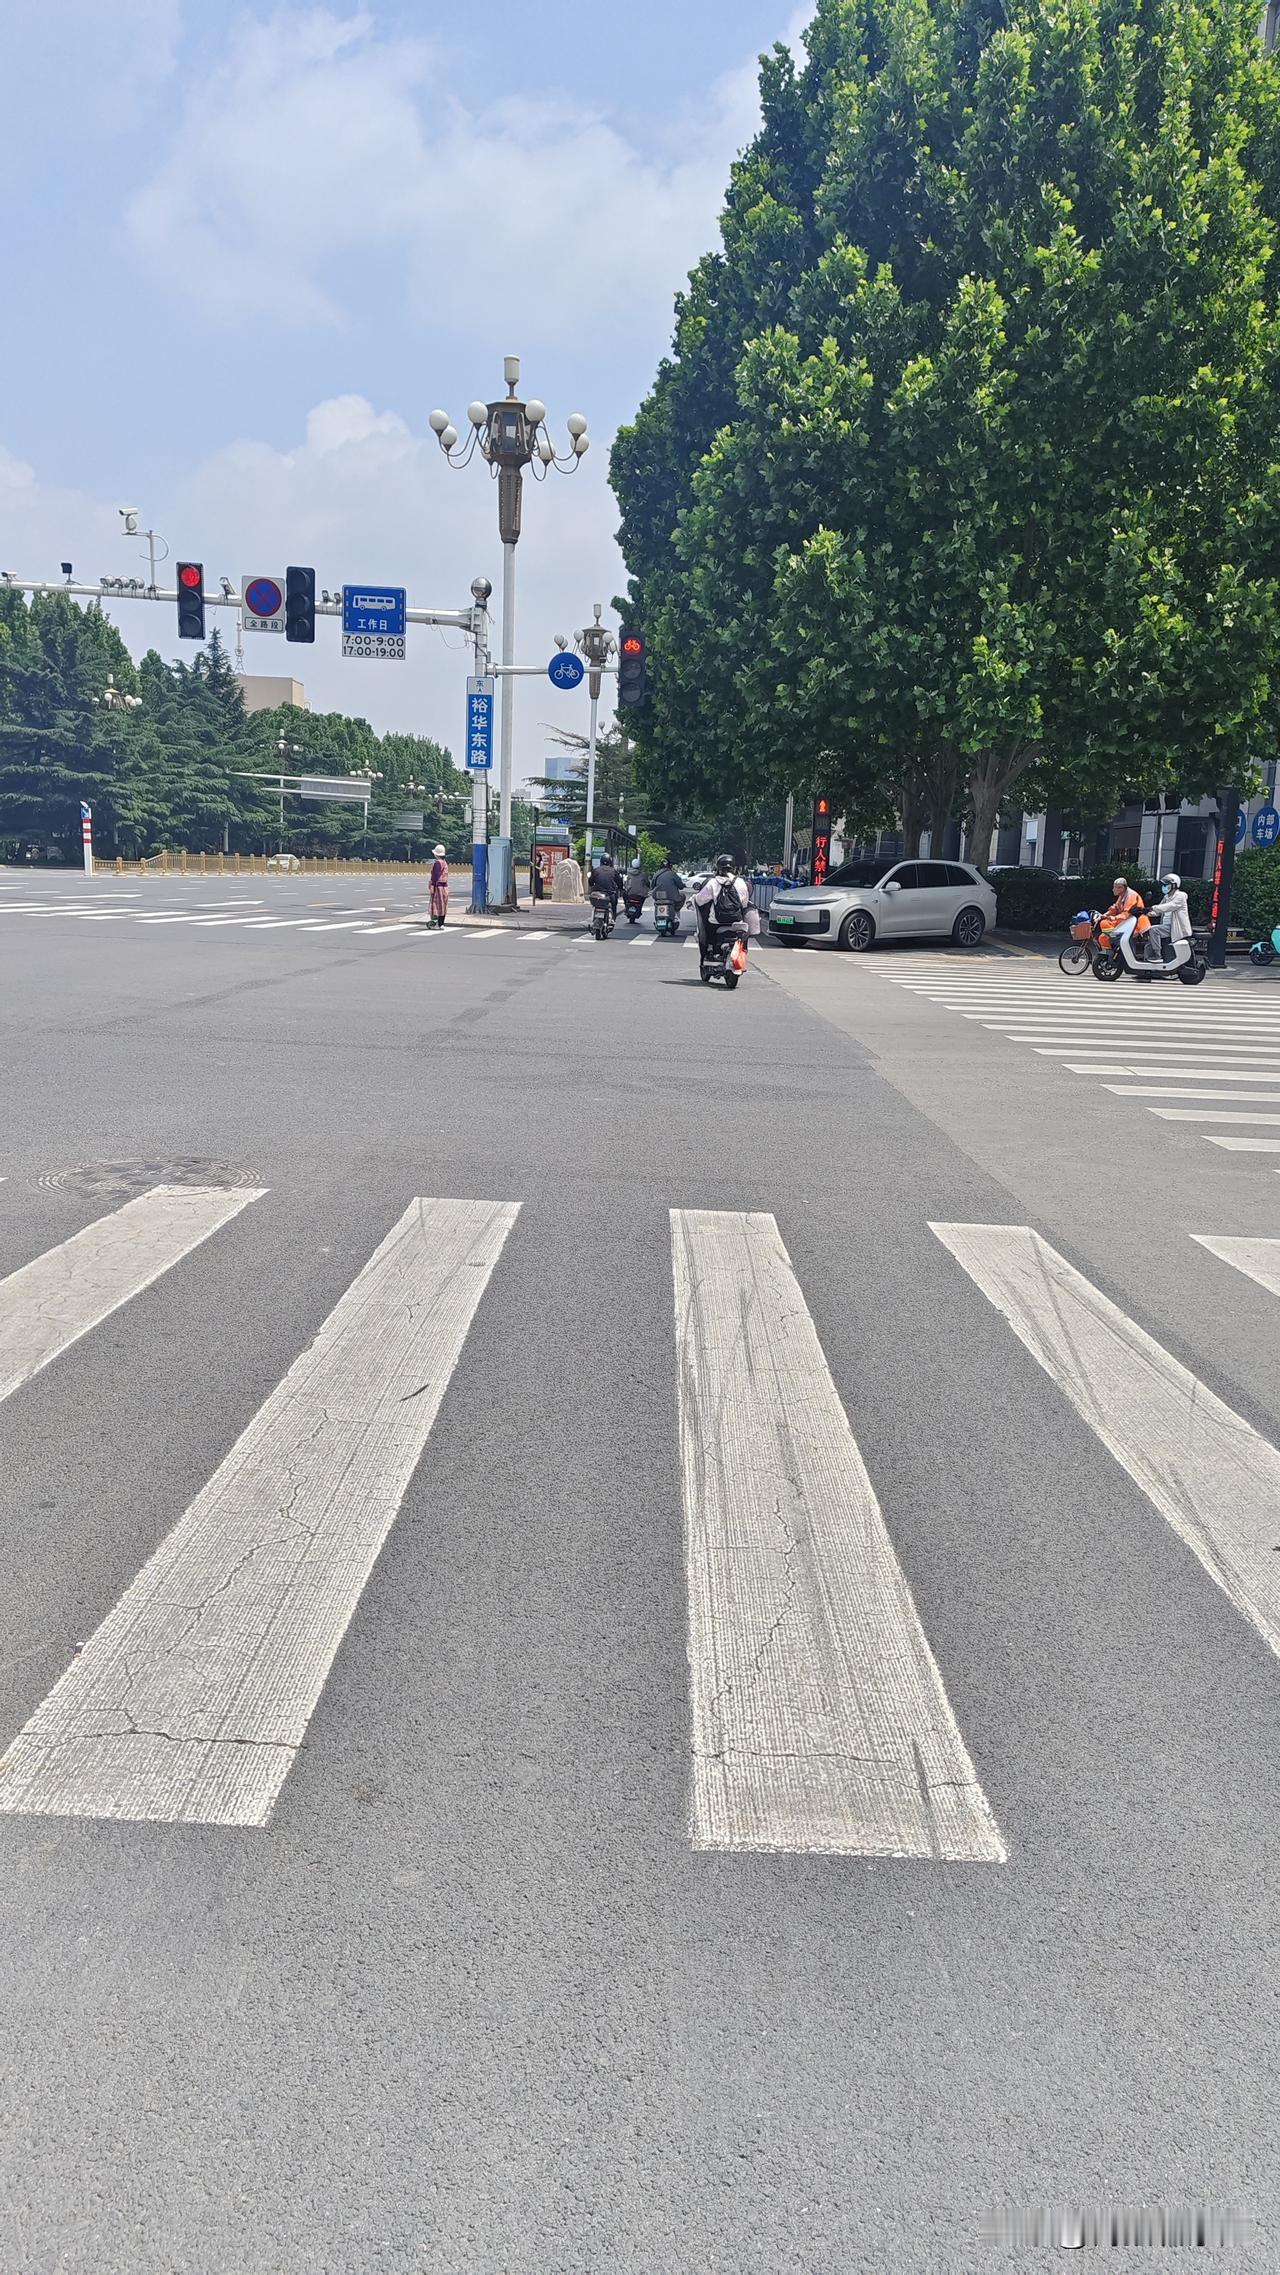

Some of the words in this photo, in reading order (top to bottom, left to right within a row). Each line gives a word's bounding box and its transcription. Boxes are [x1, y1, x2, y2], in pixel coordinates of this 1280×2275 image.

[250, 620, 279, 629] 全路段
[357, 618, 388, 631] 工作日
[343, 635, 404, 646] 7:00-9:00
[343, 646, 404, 658] 17:00-19:00
[471, 697, 488, 765] 裕华东路
[1257, 814, 1275, 826] 内部
[1255, 828, 1273, 840] 车场
